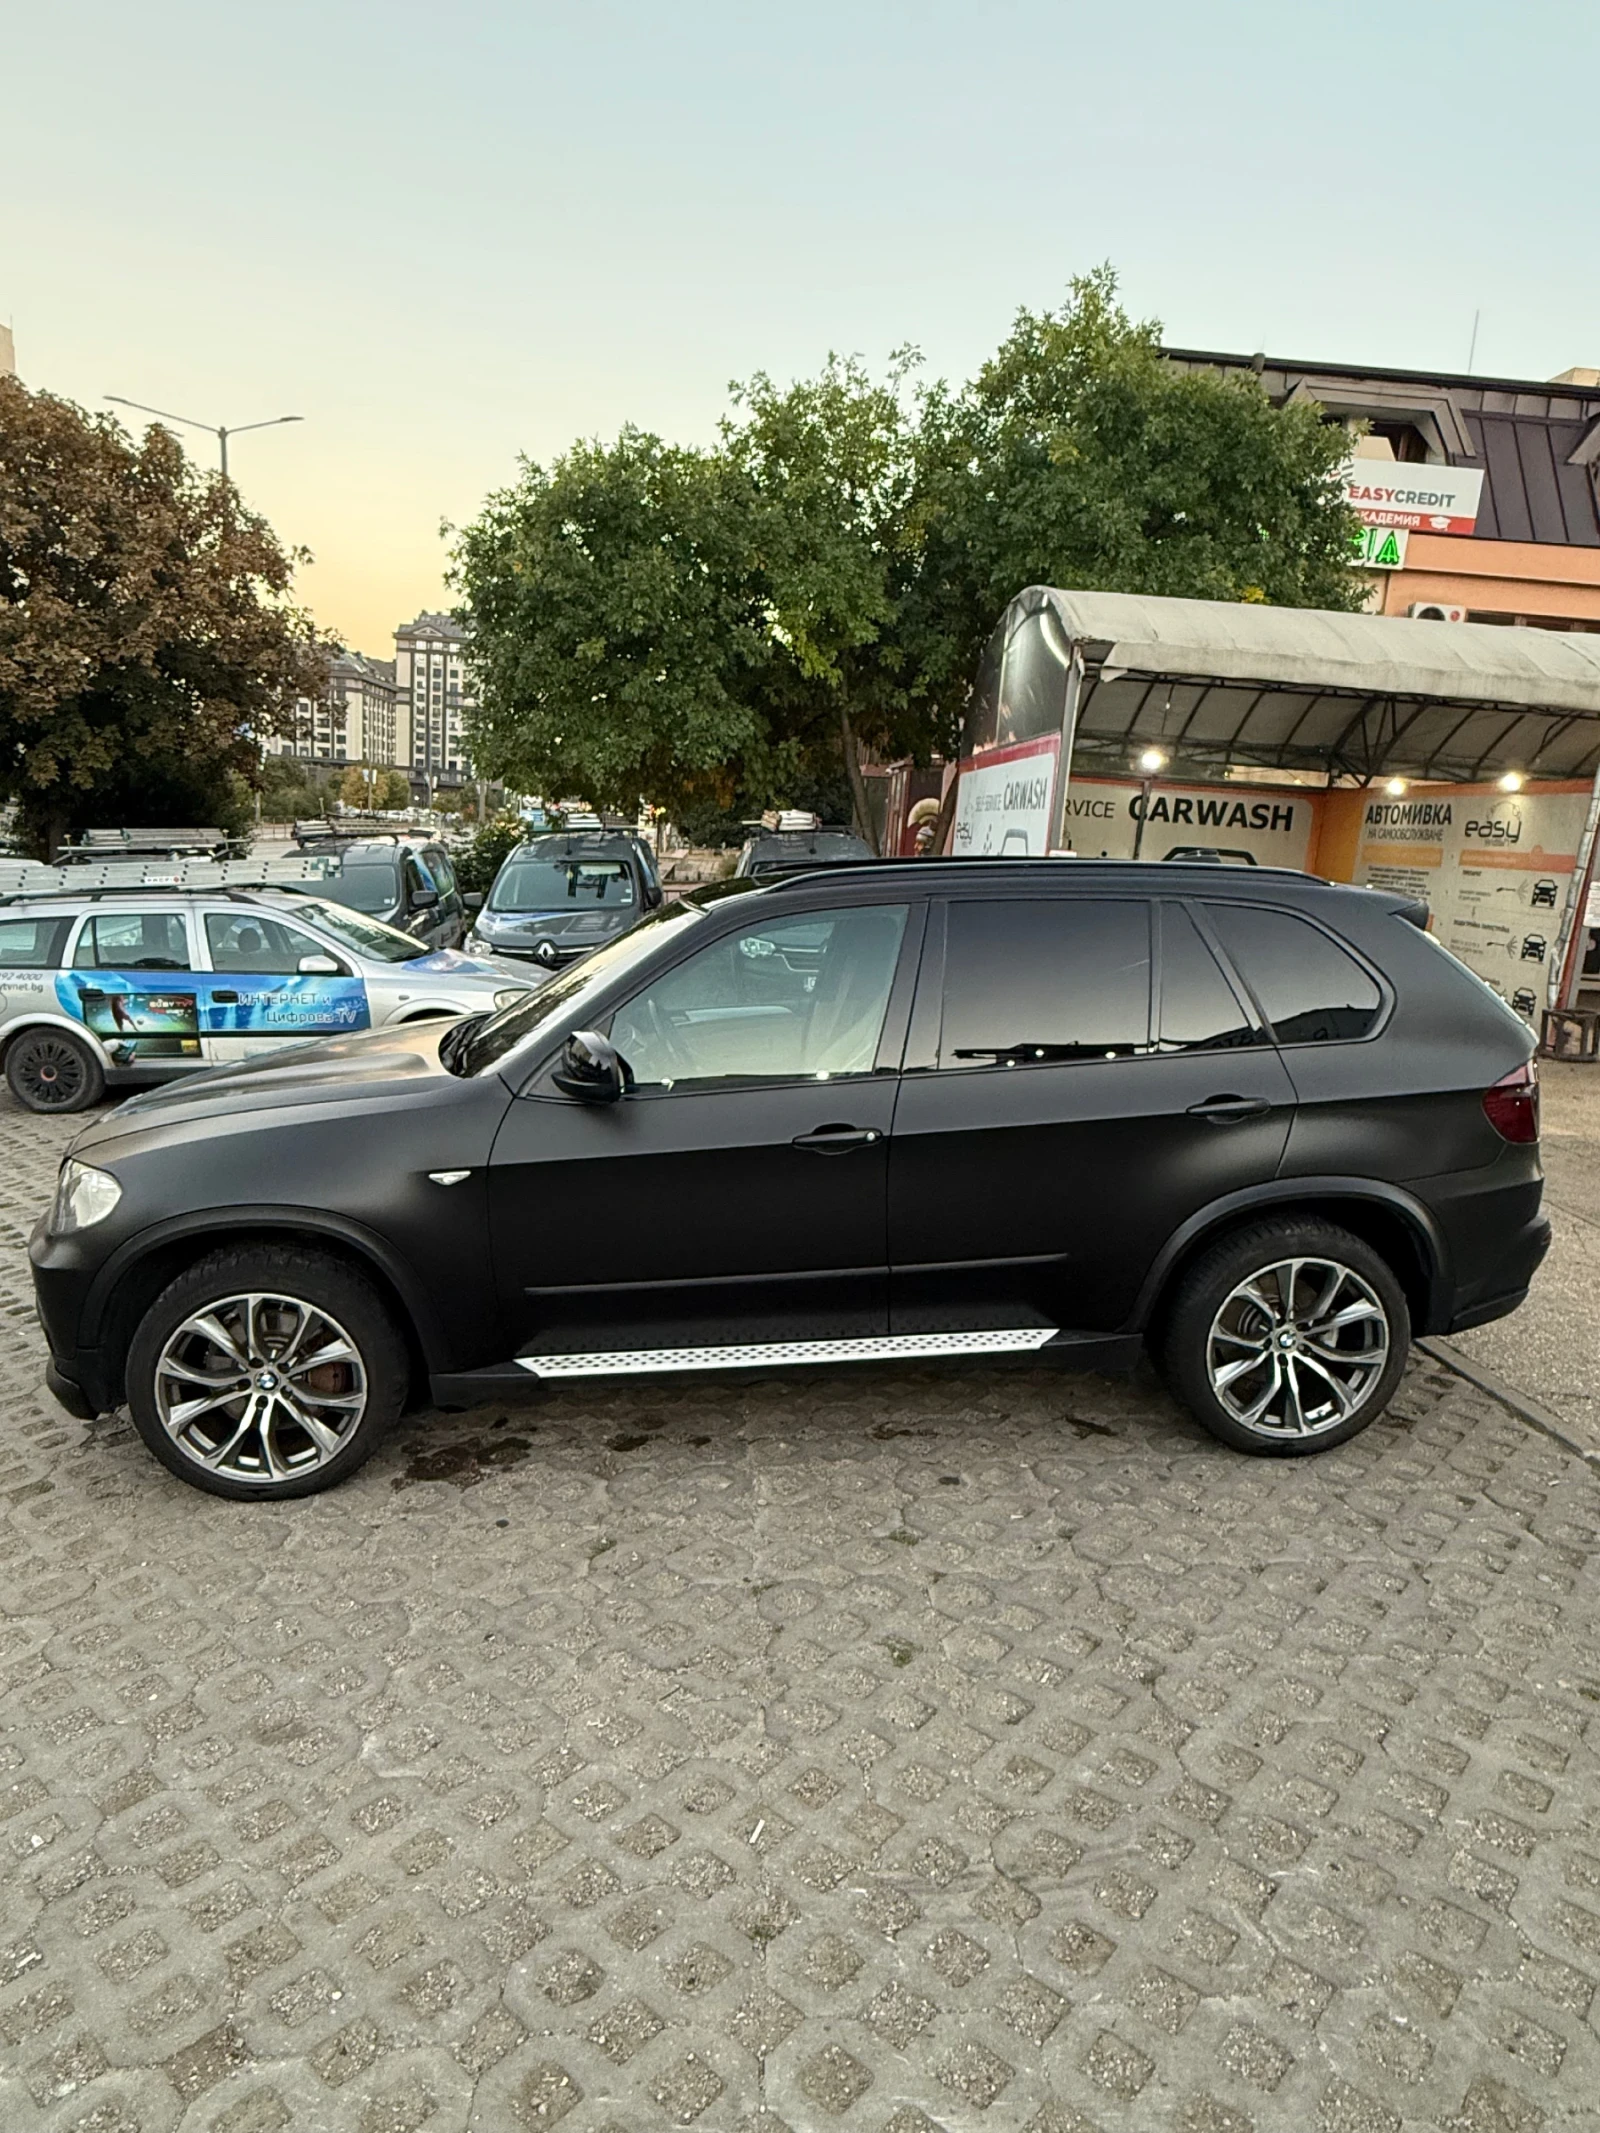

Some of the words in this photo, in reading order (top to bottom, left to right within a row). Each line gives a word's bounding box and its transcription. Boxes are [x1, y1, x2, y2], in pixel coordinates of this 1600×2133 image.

[1348, 486, 1456, 508] EASYCREDIT
[1003, 776, 1048, 812] CARWASH
[1128, 794, 1294, 832] CARWASH
[1365, 803, 1452, 826] АВТОМИВКА
[1464, 820, 1522, 843] easy
[239, 991, 318, 1006] ИНТЕРНЕТ
[266, 1009, 334, 1025] Цифрова
[338, 1007, 358, 1024] TV
